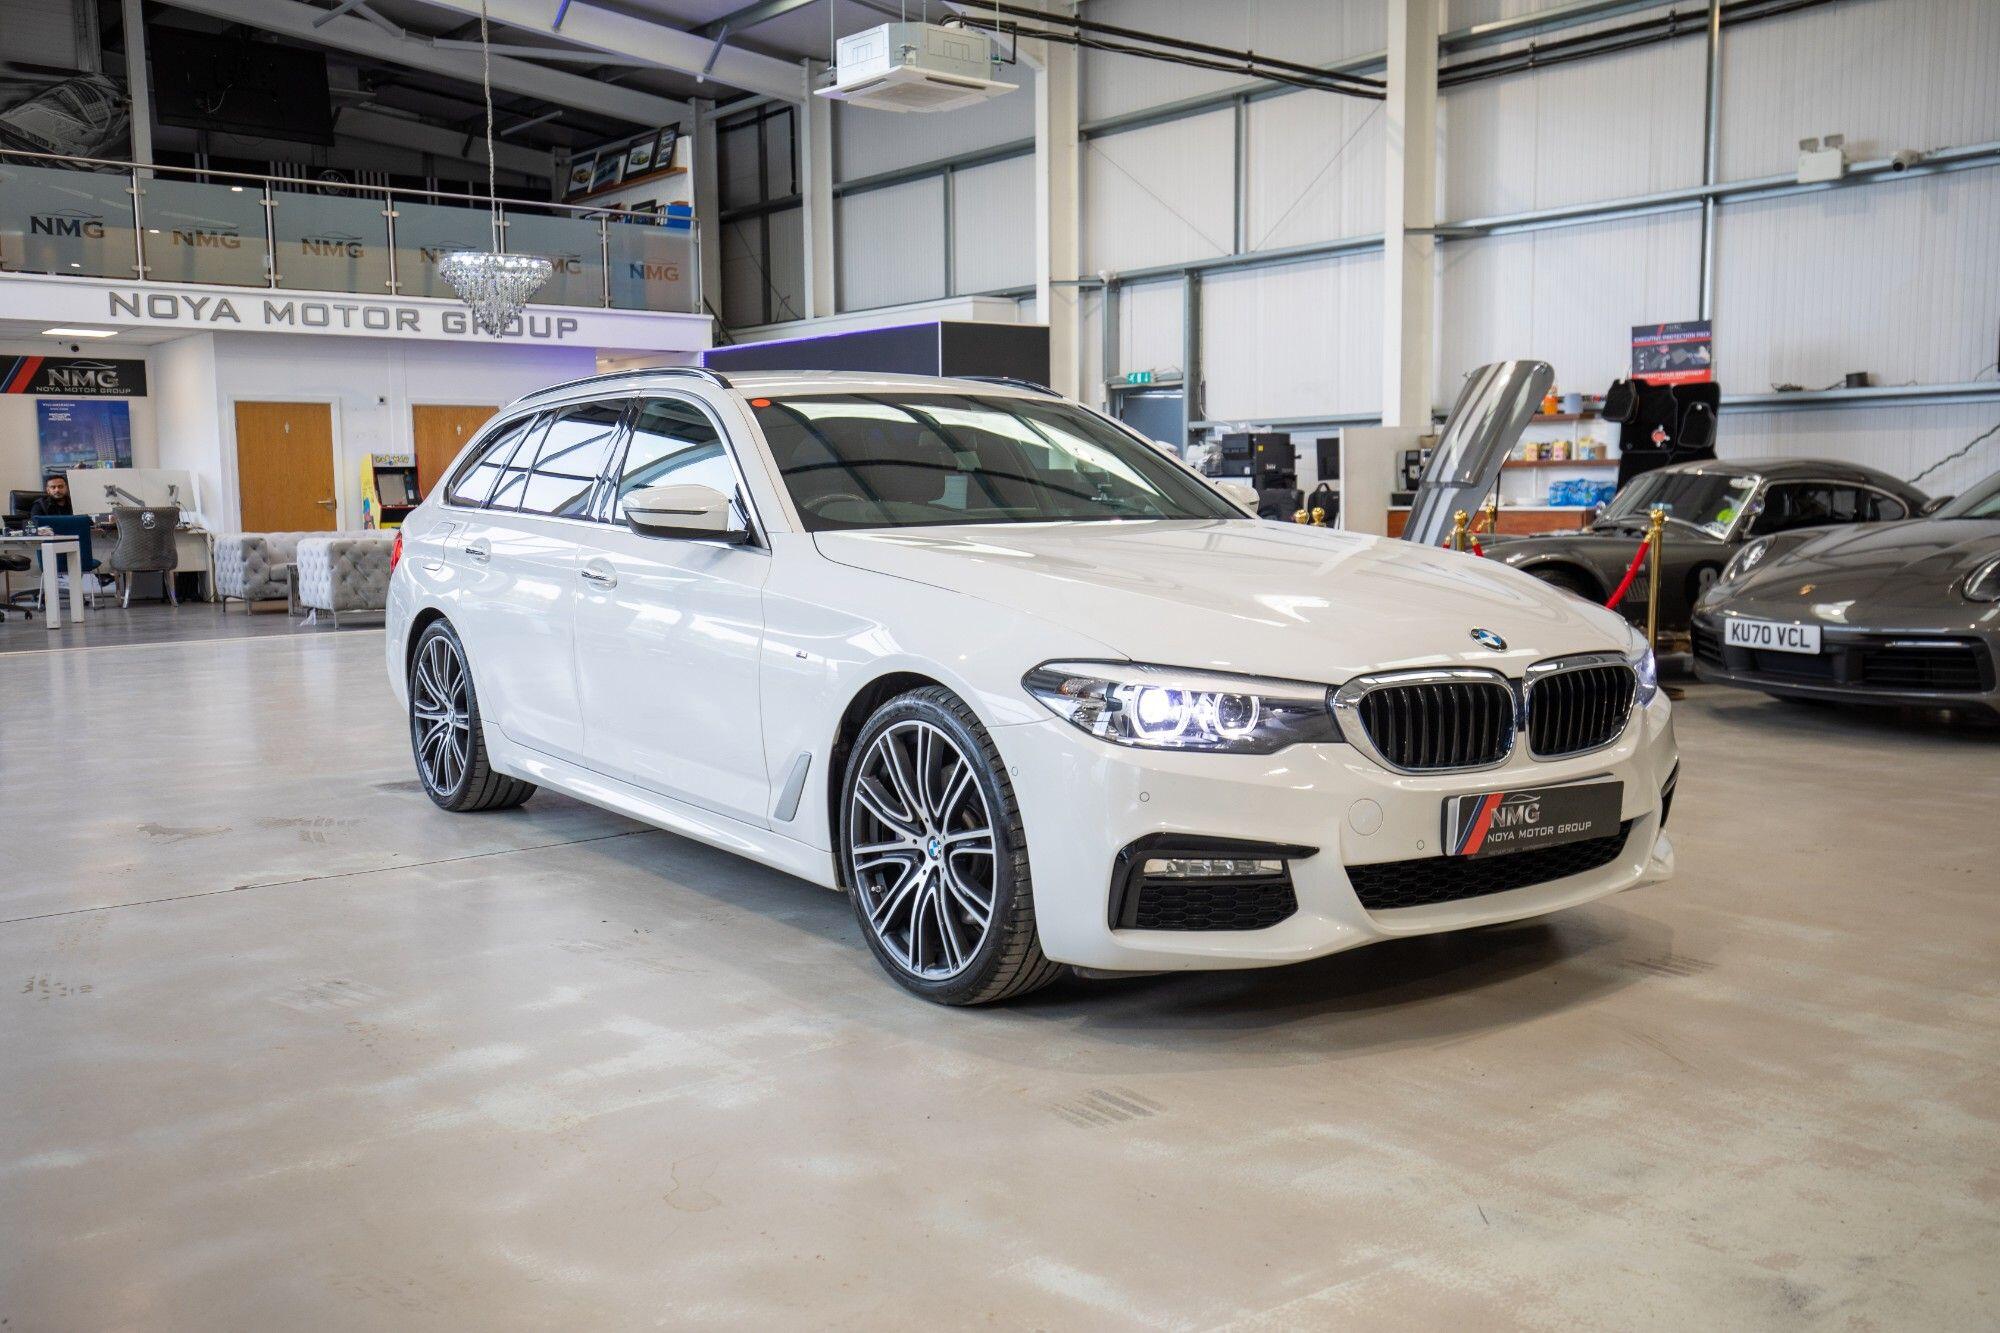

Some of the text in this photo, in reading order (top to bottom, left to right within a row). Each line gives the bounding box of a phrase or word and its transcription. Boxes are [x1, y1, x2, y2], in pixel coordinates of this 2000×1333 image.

[30, 216, 105, 239] NMG
[173, 230, 241, 249] NMG
[301, 238, 365, 258] NMG
[551, 257, 581, 275] MG
[629, 263, 680, 282] NMG
[108, 291, 241, 323] NOYA
[263, 300, 421, 332] MOTOR
[47, 369, 119, 388] NMG
[1731, 622, 1811, 649] KU70 VCL
[1489, 803, 1540, 828] NMG
[1487, 821, 1592, 843] NOYA MOTOR GROUP
